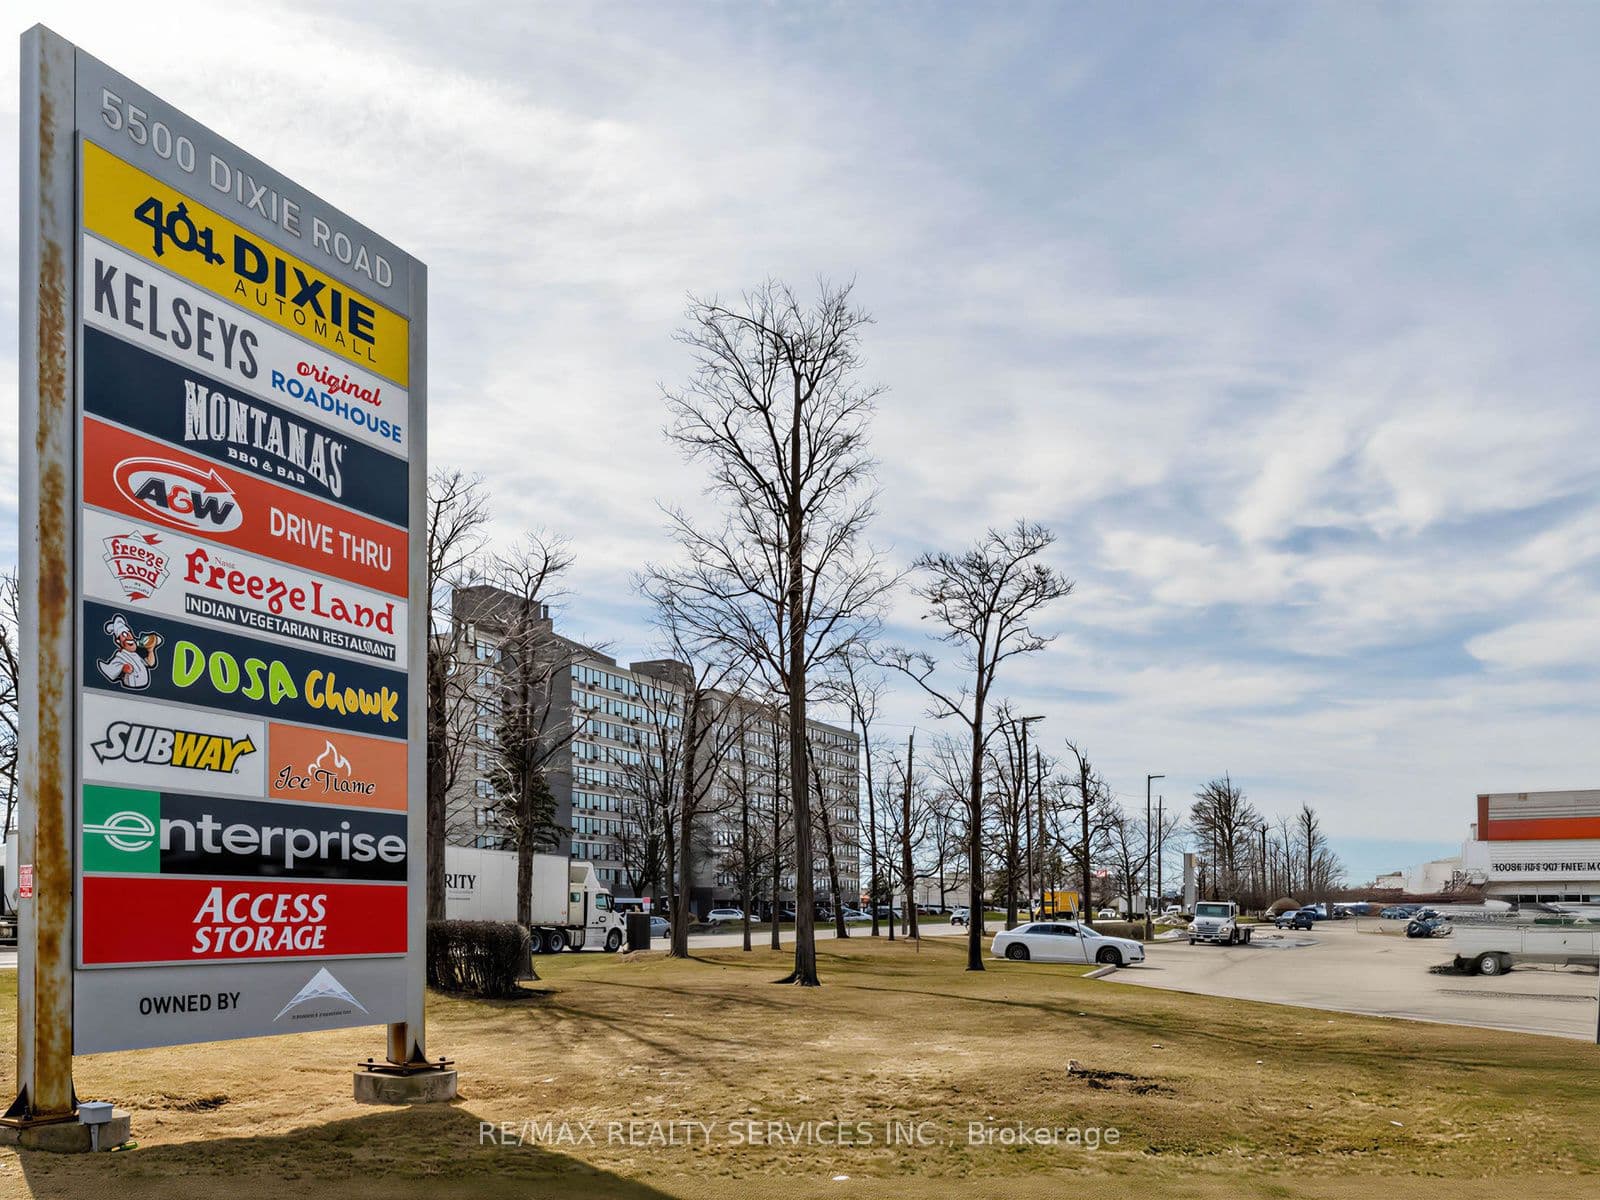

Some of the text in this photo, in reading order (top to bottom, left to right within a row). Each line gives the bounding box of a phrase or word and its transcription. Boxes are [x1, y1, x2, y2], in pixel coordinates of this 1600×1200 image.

[101, 88, 393, 288] 5500 DIXIE ROAD
[134, 197, 376, 345] 401 DIXIE
[94, 258, 259, 379] KELSEYS
[234, 279, 376, 363] AUTOMALL
[271, 369, 402, 443] ROADHOUSE
[296, 361, 382, 406] original
[184, 379, 344, 498] MONTANA'S
[227, 446, 258, 468] BBQ
[262, 460, 273, 472] &
[134, 477, 234, 525] A&W
[269, 506, 392, 572] DRIVE THRU
[186, 596, 237, 621] INDIAN
[240, 609, 320, 641] VEGETARIAN
[172, 640, 298, 705] DOSA
[91, 721, 257, 773] SUBWAY
[103, 811, 407, 869] enterprise
[192, 925, 327, 953] STORAGE
[139, 992, 241, 1015] OWNED BY
